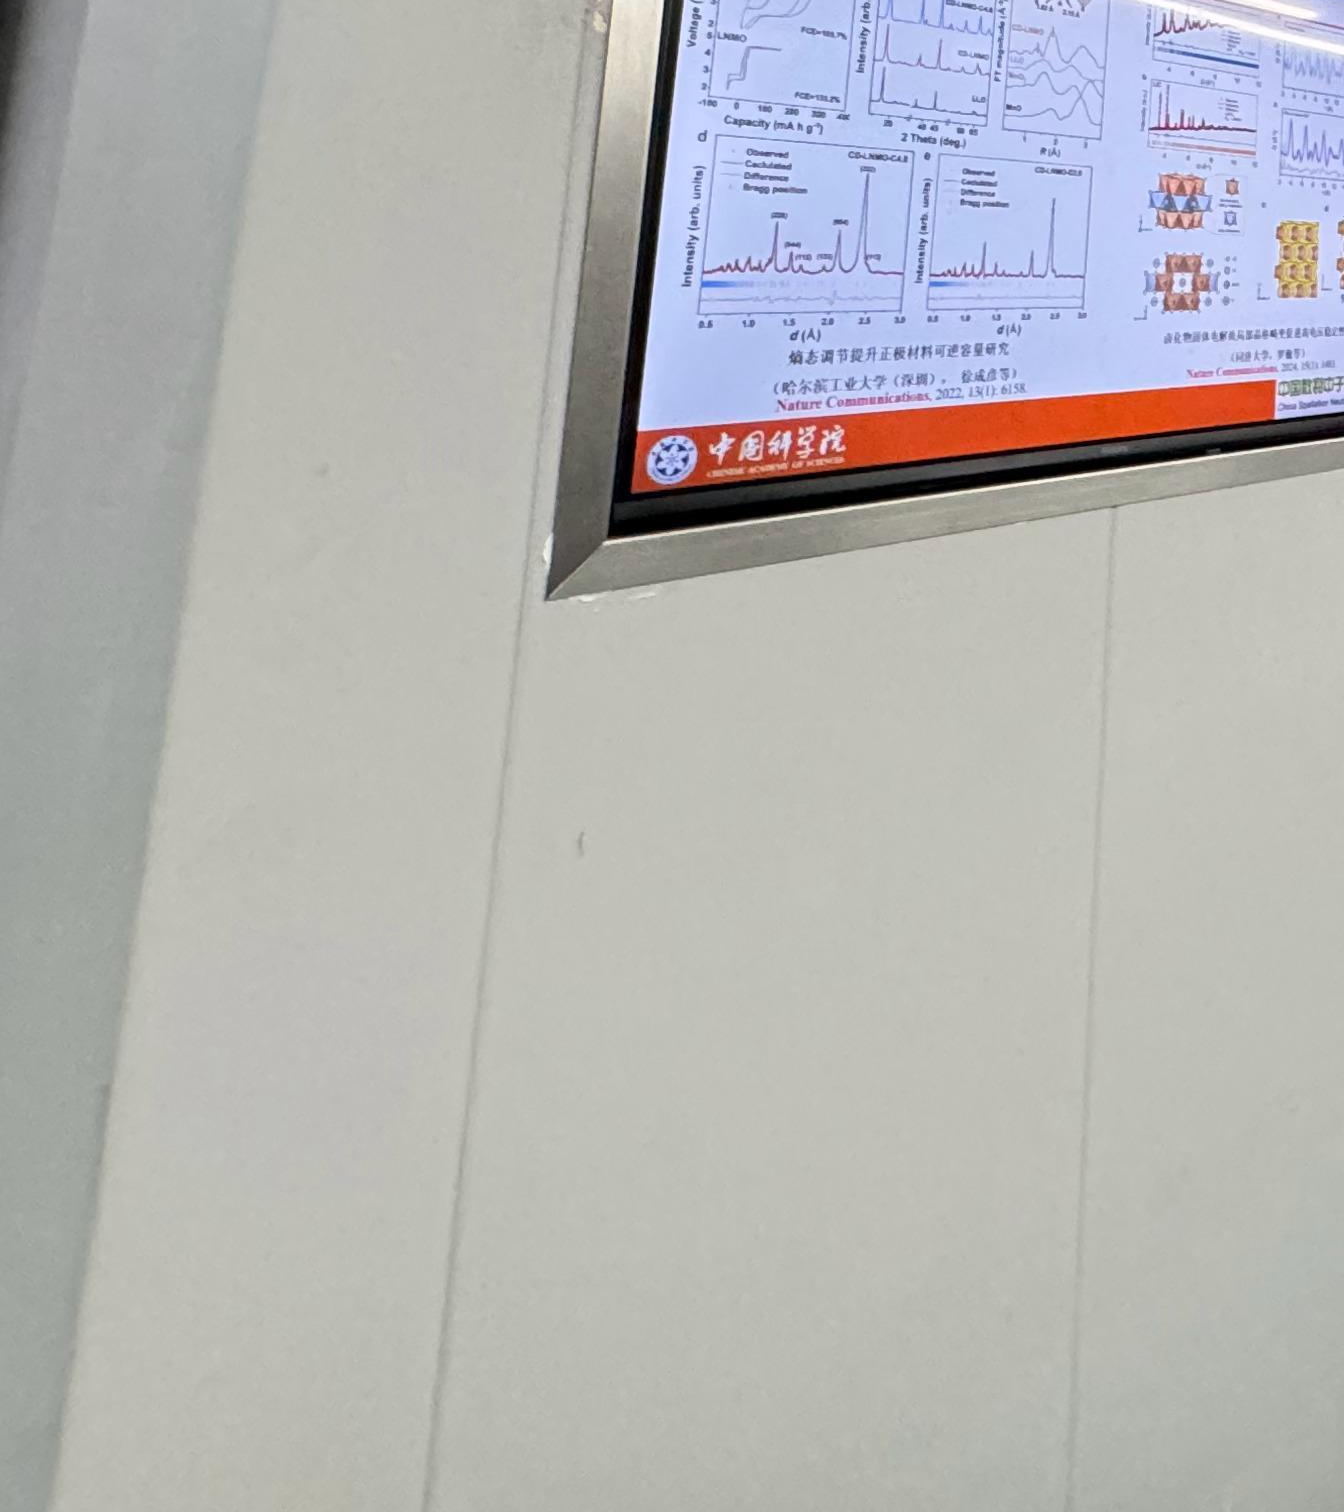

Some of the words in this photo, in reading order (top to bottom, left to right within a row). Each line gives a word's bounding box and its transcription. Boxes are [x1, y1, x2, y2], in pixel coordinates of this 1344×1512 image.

[686, 5, 702, 48] Voltage
[855, 26, 871, 74] Intensity
[723, 114, 771, 129] Capacity
[773, 119, 794, 131] (mA
[697, 129, 708, 142] d
[909, 133, 937, 144] Theta
[939, 136, 966, 149] (deg.)
[745, 148, 789, 158] Observed
[690, 165, 706, 197] units)
[742, 182, 770, 194] Bragg
[771, 186, 808, 195] position
[743, 171, 789, 182] Difference
[687, 202, 702, 231] (arb.
[681, 234, 700, 287] Intensity
[914, 238, 927, 283] Intensity
[789, 330, 799, 341] d
[775, 396, 823, 412] Nature
[825, 388, 933, 408] Communications,
[707, 421, 849, 468] 中国科学院
